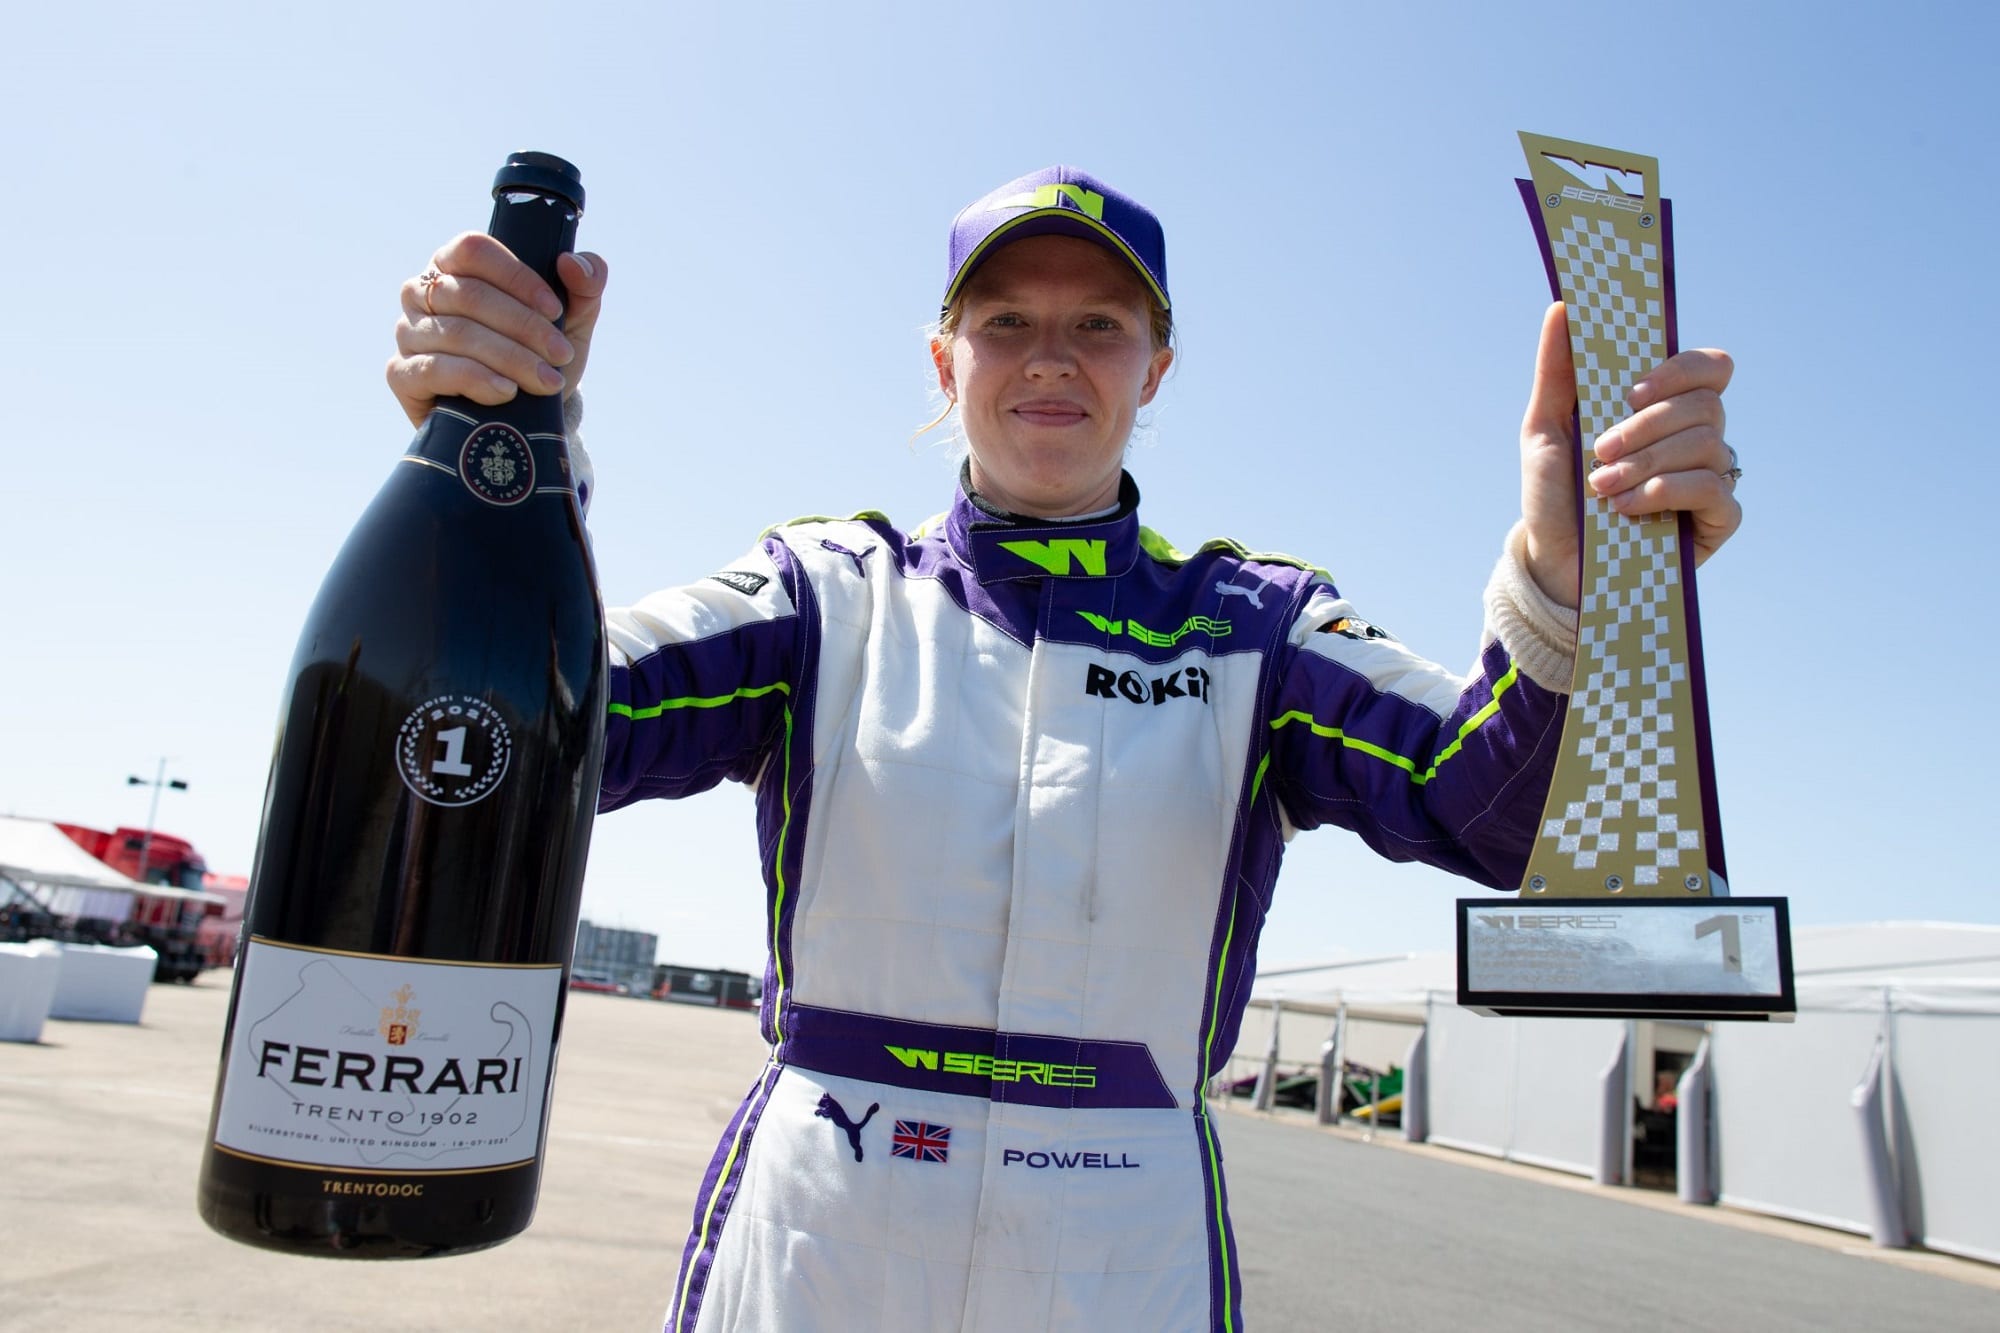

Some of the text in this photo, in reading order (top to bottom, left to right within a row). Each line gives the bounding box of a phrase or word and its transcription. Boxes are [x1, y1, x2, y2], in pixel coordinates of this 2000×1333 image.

[1560, 185, 1645, 213] SERIES
[1128, 616, 1232, 648] SERIES
[432, 726, 472, 777] 1
[1518, 914, 1622, 930] SERIES
[257, 1040, 522, 1095] FERRARI
[292, 1102, 478, 1125] TRENTO 1902
[329, 1135, 376, 1147] UNITED
[380, 1139, 437, 1148] KINGDOM
[1003, 1149, 1140, 1169] POWELL
[322, 1180, 424, 1197] TRENTODOC
